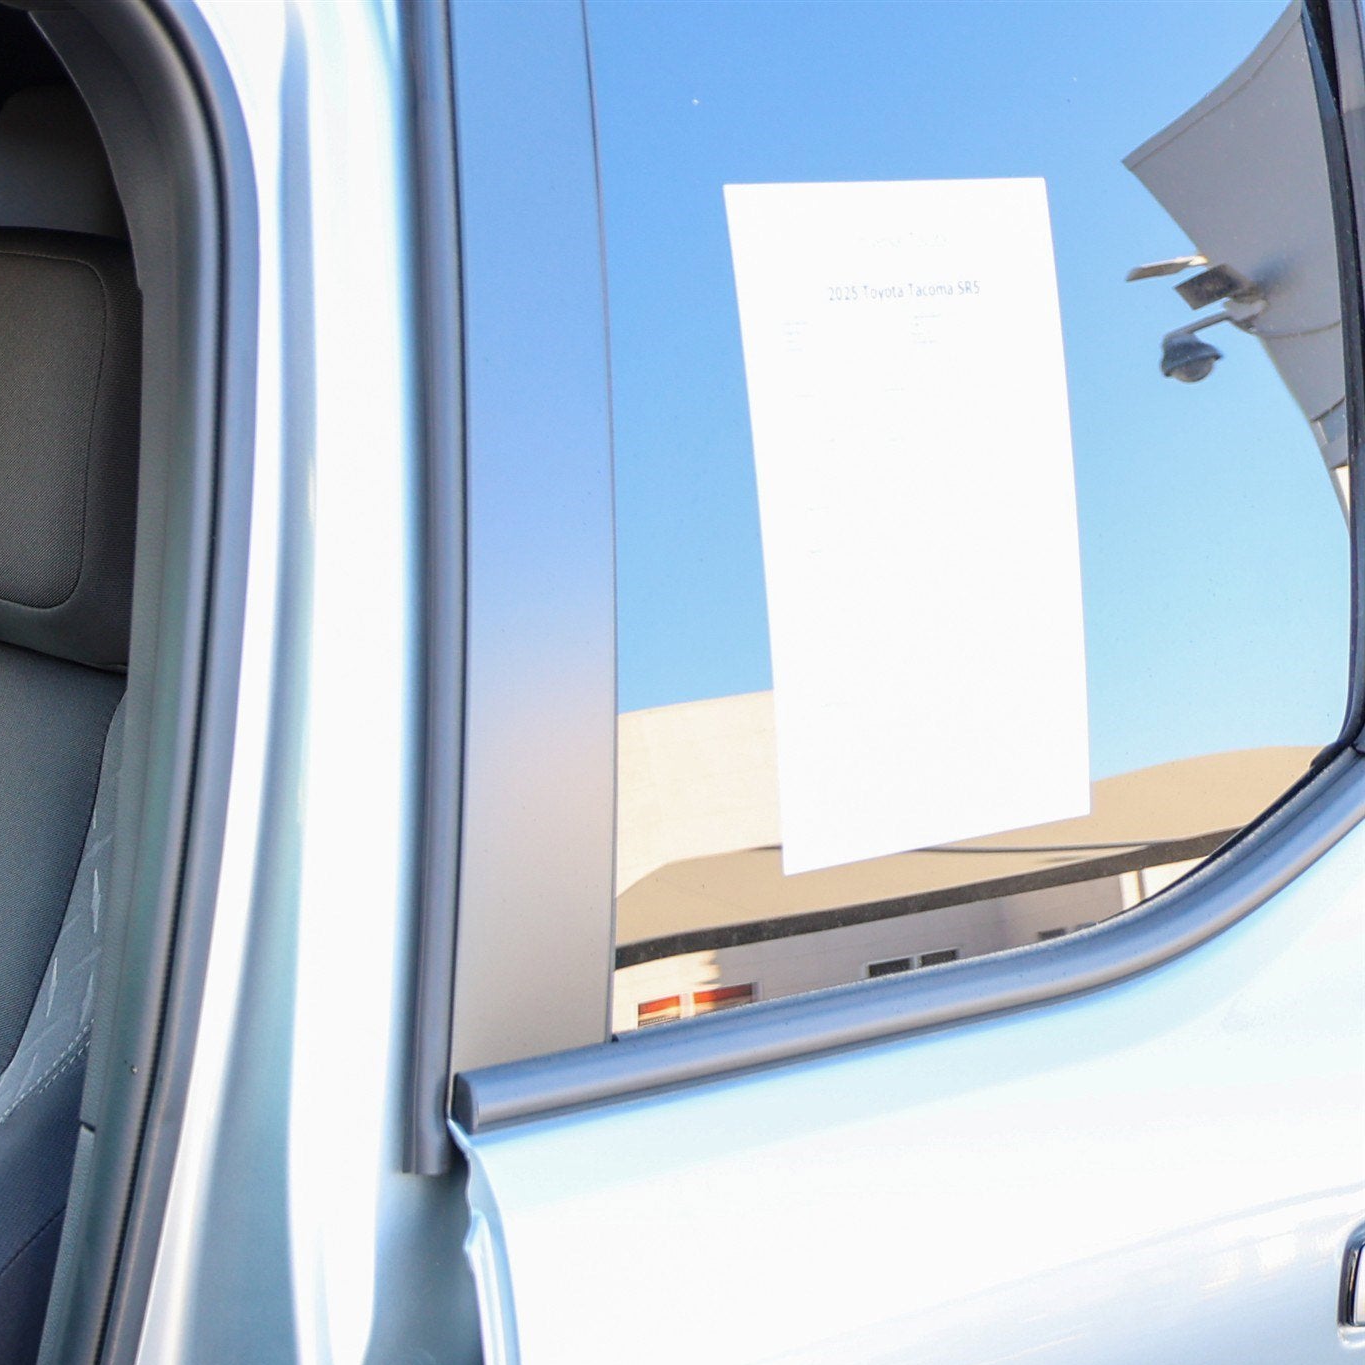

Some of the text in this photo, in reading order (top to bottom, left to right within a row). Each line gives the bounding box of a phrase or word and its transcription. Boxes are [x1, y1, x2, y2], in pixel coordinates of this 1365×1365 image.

[829, 280, 980, 301] 2025 Toyota Tacoma SR5
